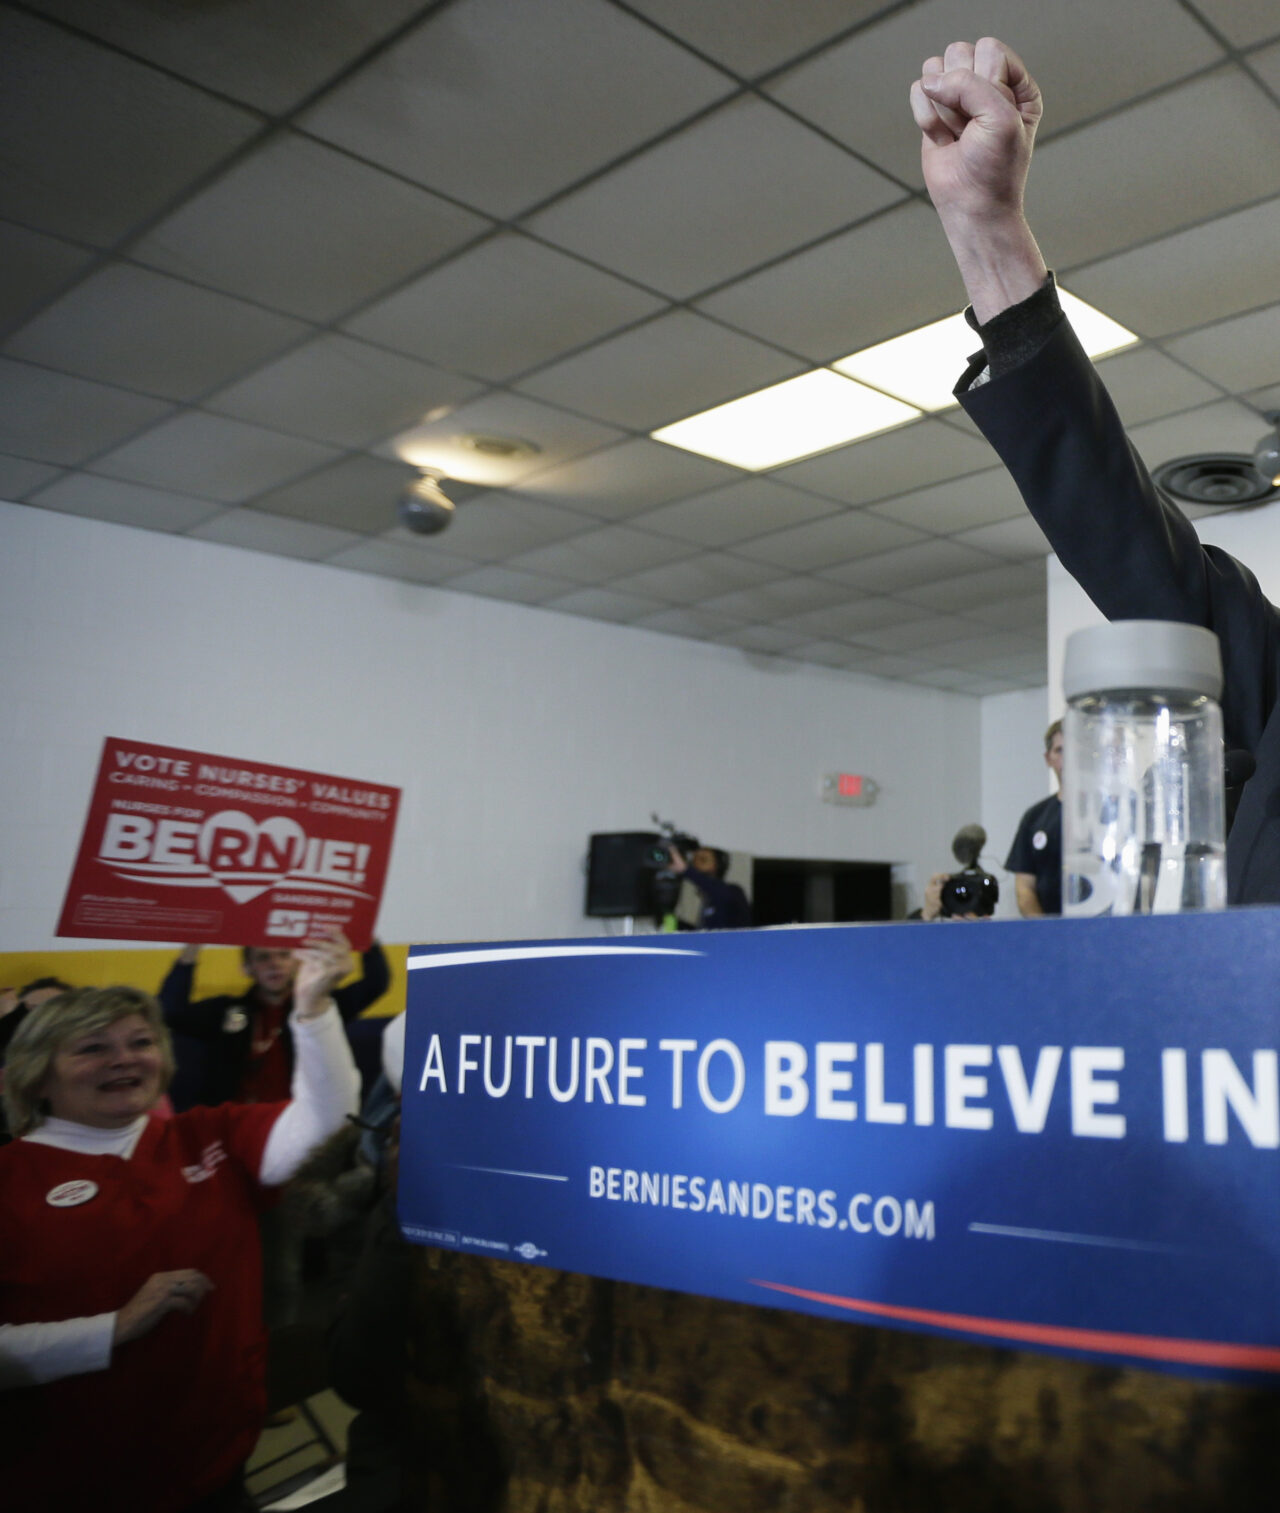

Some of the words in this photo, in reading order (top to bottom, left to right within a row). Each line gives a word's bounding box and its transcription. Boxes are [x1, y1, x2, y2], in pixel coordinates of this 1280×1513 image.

[109, 771, 180, 792] CARING
[115, 751, 192, 777] VOTE
[198, 764, 306, 794] NURSES'
[311, 782, 392, 809] VALUES
[99, 813, 371, 884] BERNIE!
[418, 1033, 448, 1094] A
[457, 1035, 648, 1107] FUTURE
[658, 1037, 746, 1114] TO
[763, 1040, 1127, 1140] BELIEVE
[588, 1165, 936, 1241] BERNIESANDERS.COM
